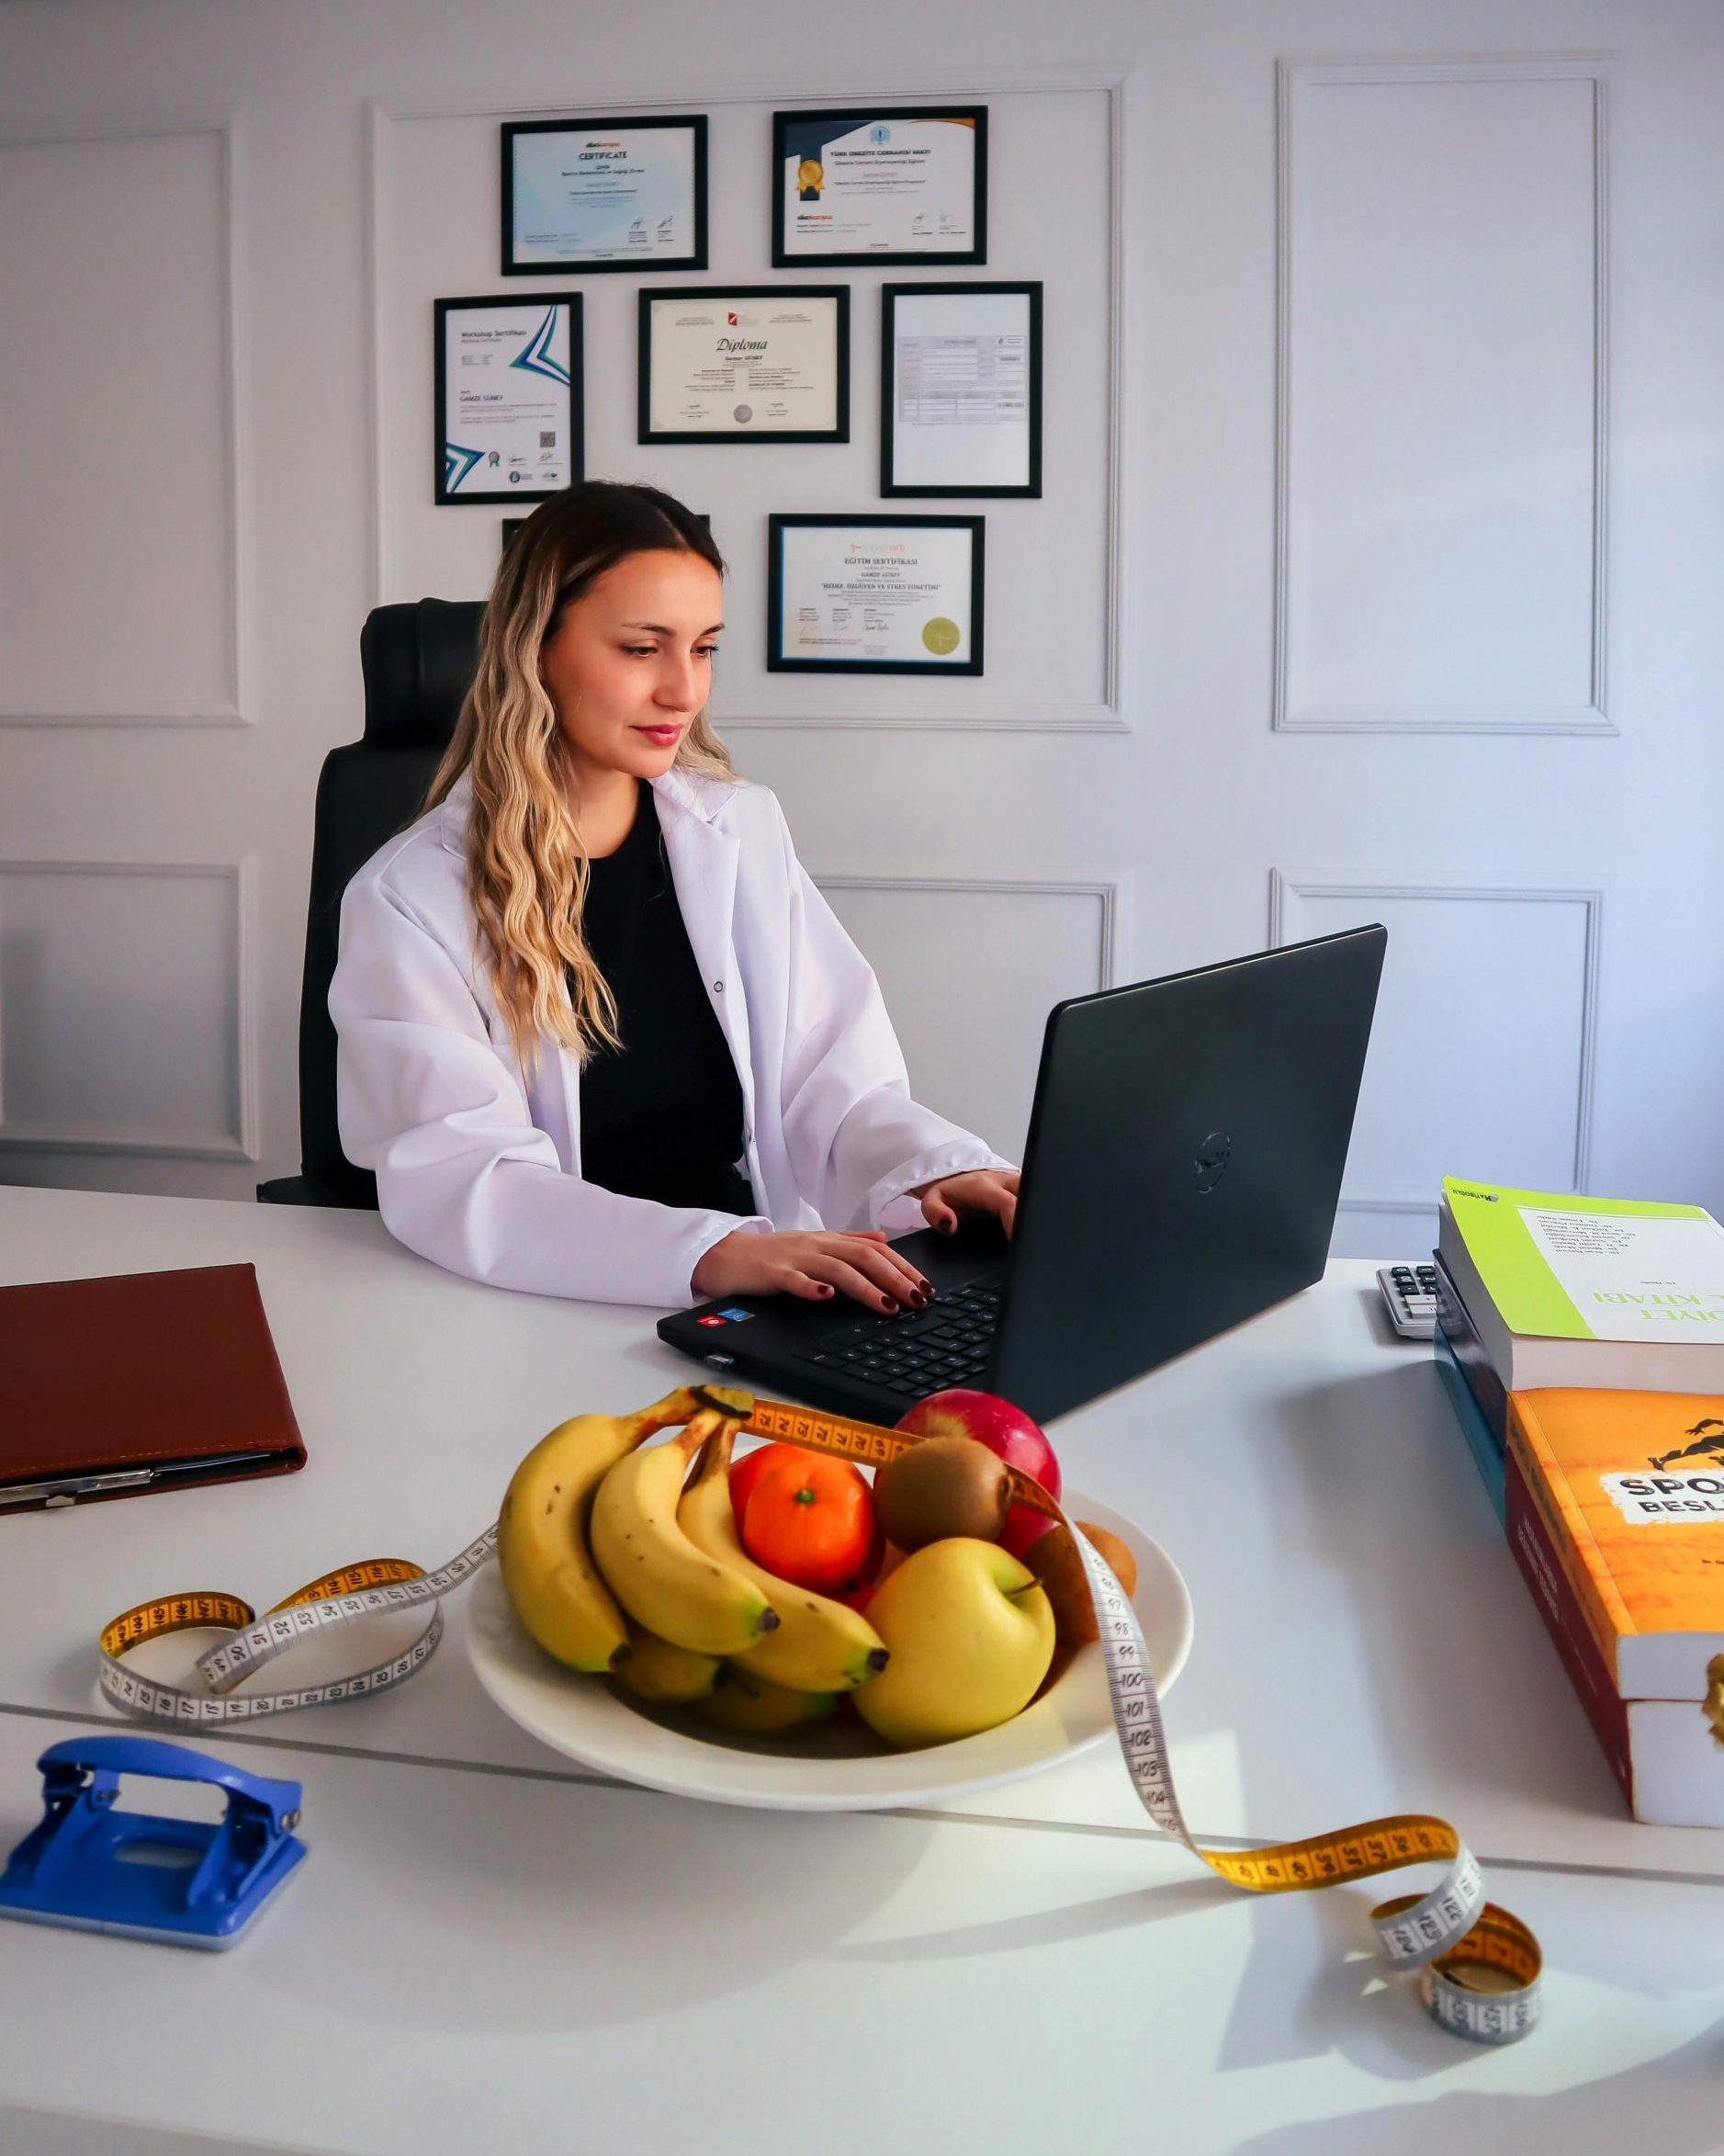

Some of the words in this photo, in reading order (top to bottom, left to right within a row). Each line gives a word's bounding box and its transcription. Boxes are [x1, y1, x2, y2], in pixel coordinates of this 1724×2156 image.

[579, 152, 627, 160] CERTIFICATE
[716, 338, 768, 353] Diploma
[844, 557, 871, 565] EĞİTİM
[1619, 1478, 1724, 1496] SPO
[1638, 1500, 1724, 1513] BESL
[328, 1579, 343, 1595] 114
[348, 1570, 363, 1586] 115
[372, 1565, 384, 1578] 116
[133, 1616, 143, 1634] 144
[153, 1607, 165, 1625] 145
[175, 1603, 188, 1620] 146
[198, 1599, 210, 1617] 147
[231, 1646, 246, 1661] 50
[251, 1633, 268, 1645] 51
[274, 1620, 290, 1635] 52
[297, 1611, 314, 1625] 53
[321, 1604, 338, 1617] 54
[344, 1599, 361, 1610] 55
[368, 1595, 382, 1605] 56
[387, 1590, 404, 1600] 57
[408, 1585, 425, 1595] 58
[430, 1575, 447, 1586] 59
[1114, 1622, 1130, 1635] 98
[1119, 1645, 1135, 1660] 99
[159, 1698, 172, 1710] 16
[182, 1701, 195, 1714] 17
[206, 1702, 220, 1715] 18
[230, 1703, 243, 1713] 19
[256, 1699, 269, 1710] 20
[305, 1693, 318, 1702] 22
[329, 1687, 343, 1698] 23
[352, 1680, 366, 1692] 24
[376, 1671, 389, 1684] 25
[397, 1660, 409, 1674] 26
[1121, 1673, 1144, 1688] 100
[1126, 1701, 1144, 1717] 101
[1132, 1730, 1152, 1746] 102
[1137, 1761, 1157, 1777] 103
[1368, 1840, 1388, 1860] 37
[1442, 1897, 1464, 1921] 122
